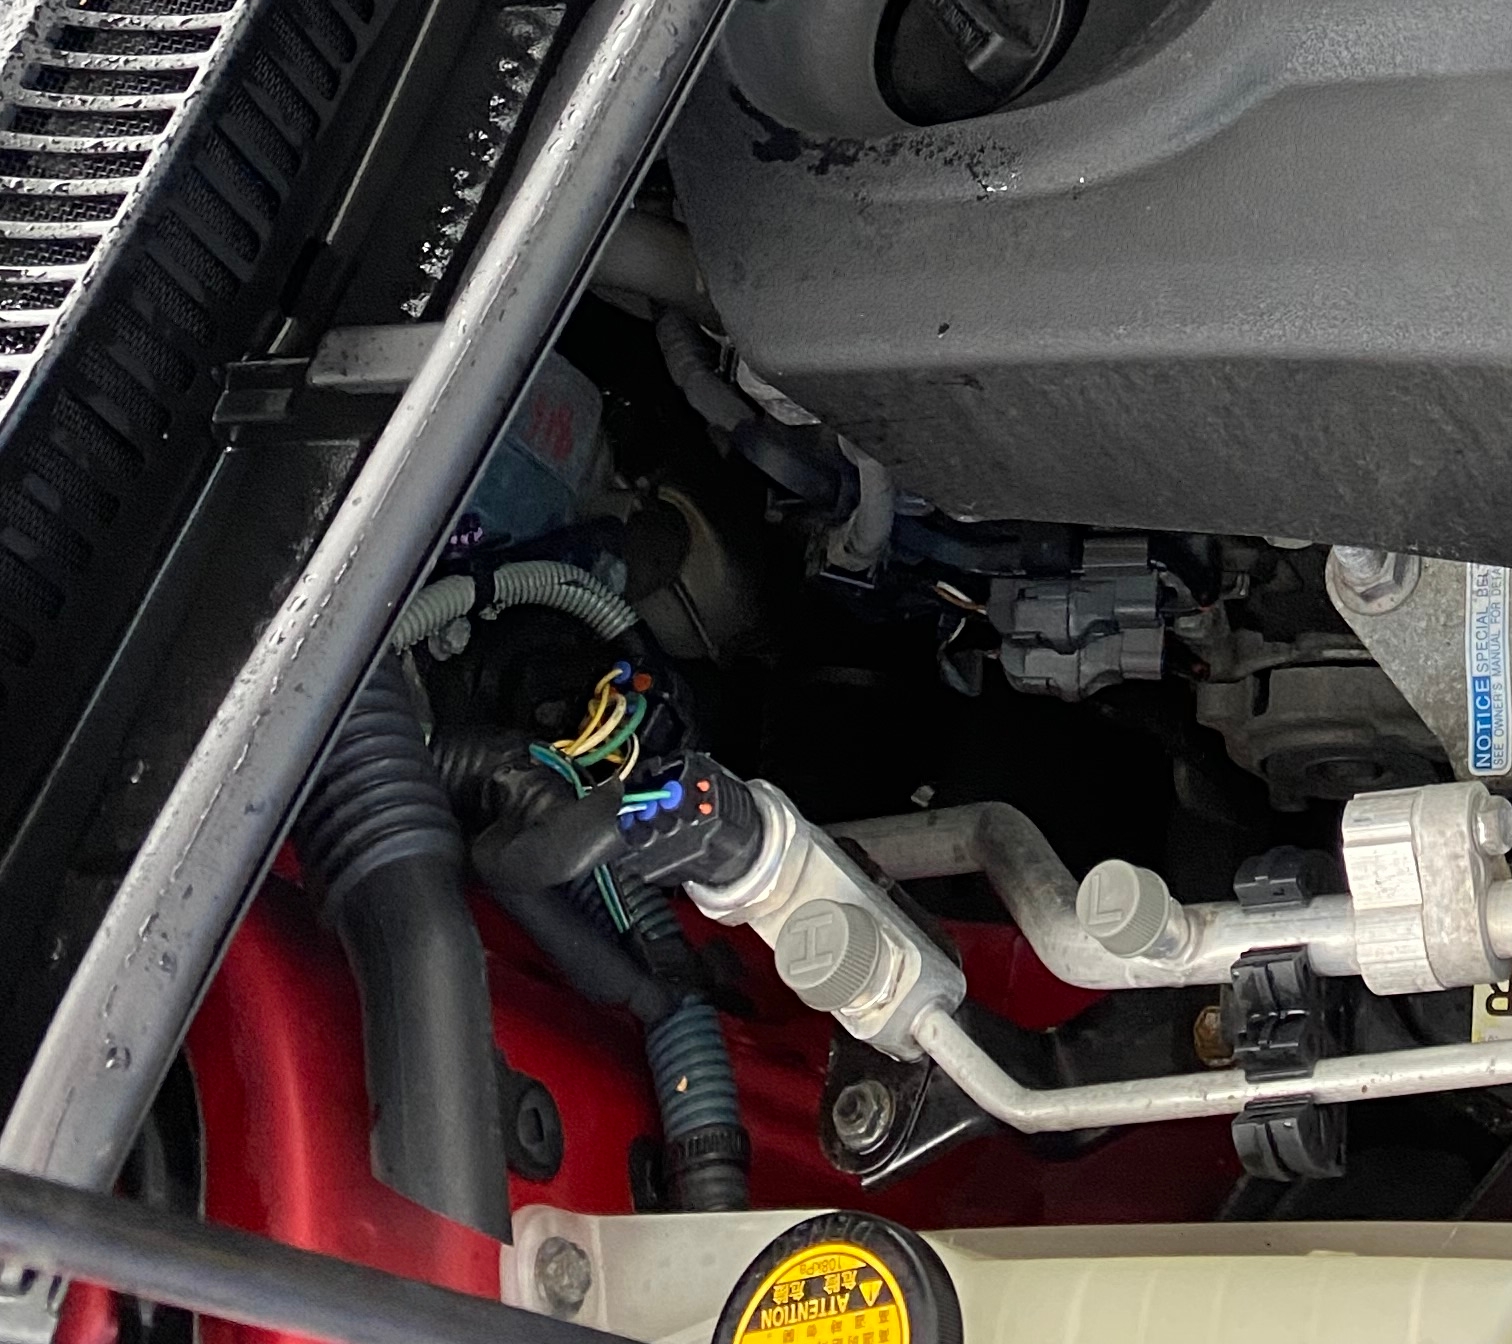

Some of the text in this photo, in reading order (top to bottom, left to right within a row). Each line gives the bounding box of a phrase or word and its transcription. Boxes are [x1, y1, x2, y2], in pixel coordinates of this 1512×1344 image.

[1475, 605, 1490, 673] SPECIAL
[1490, 602, 1502, 625] FOR
[1490, 630, 1502, 677] MANUAL
[1474, 679, 1492, 768] NOTICE
[1491, 682, 1504, 738] OWNER'S
[1492, 743, 1505, 766] SEE
[1082, 874, 1124, 931] L
[786, 913, 835, 976] H
[760, 1292, 851, 1330] ATTENTION
